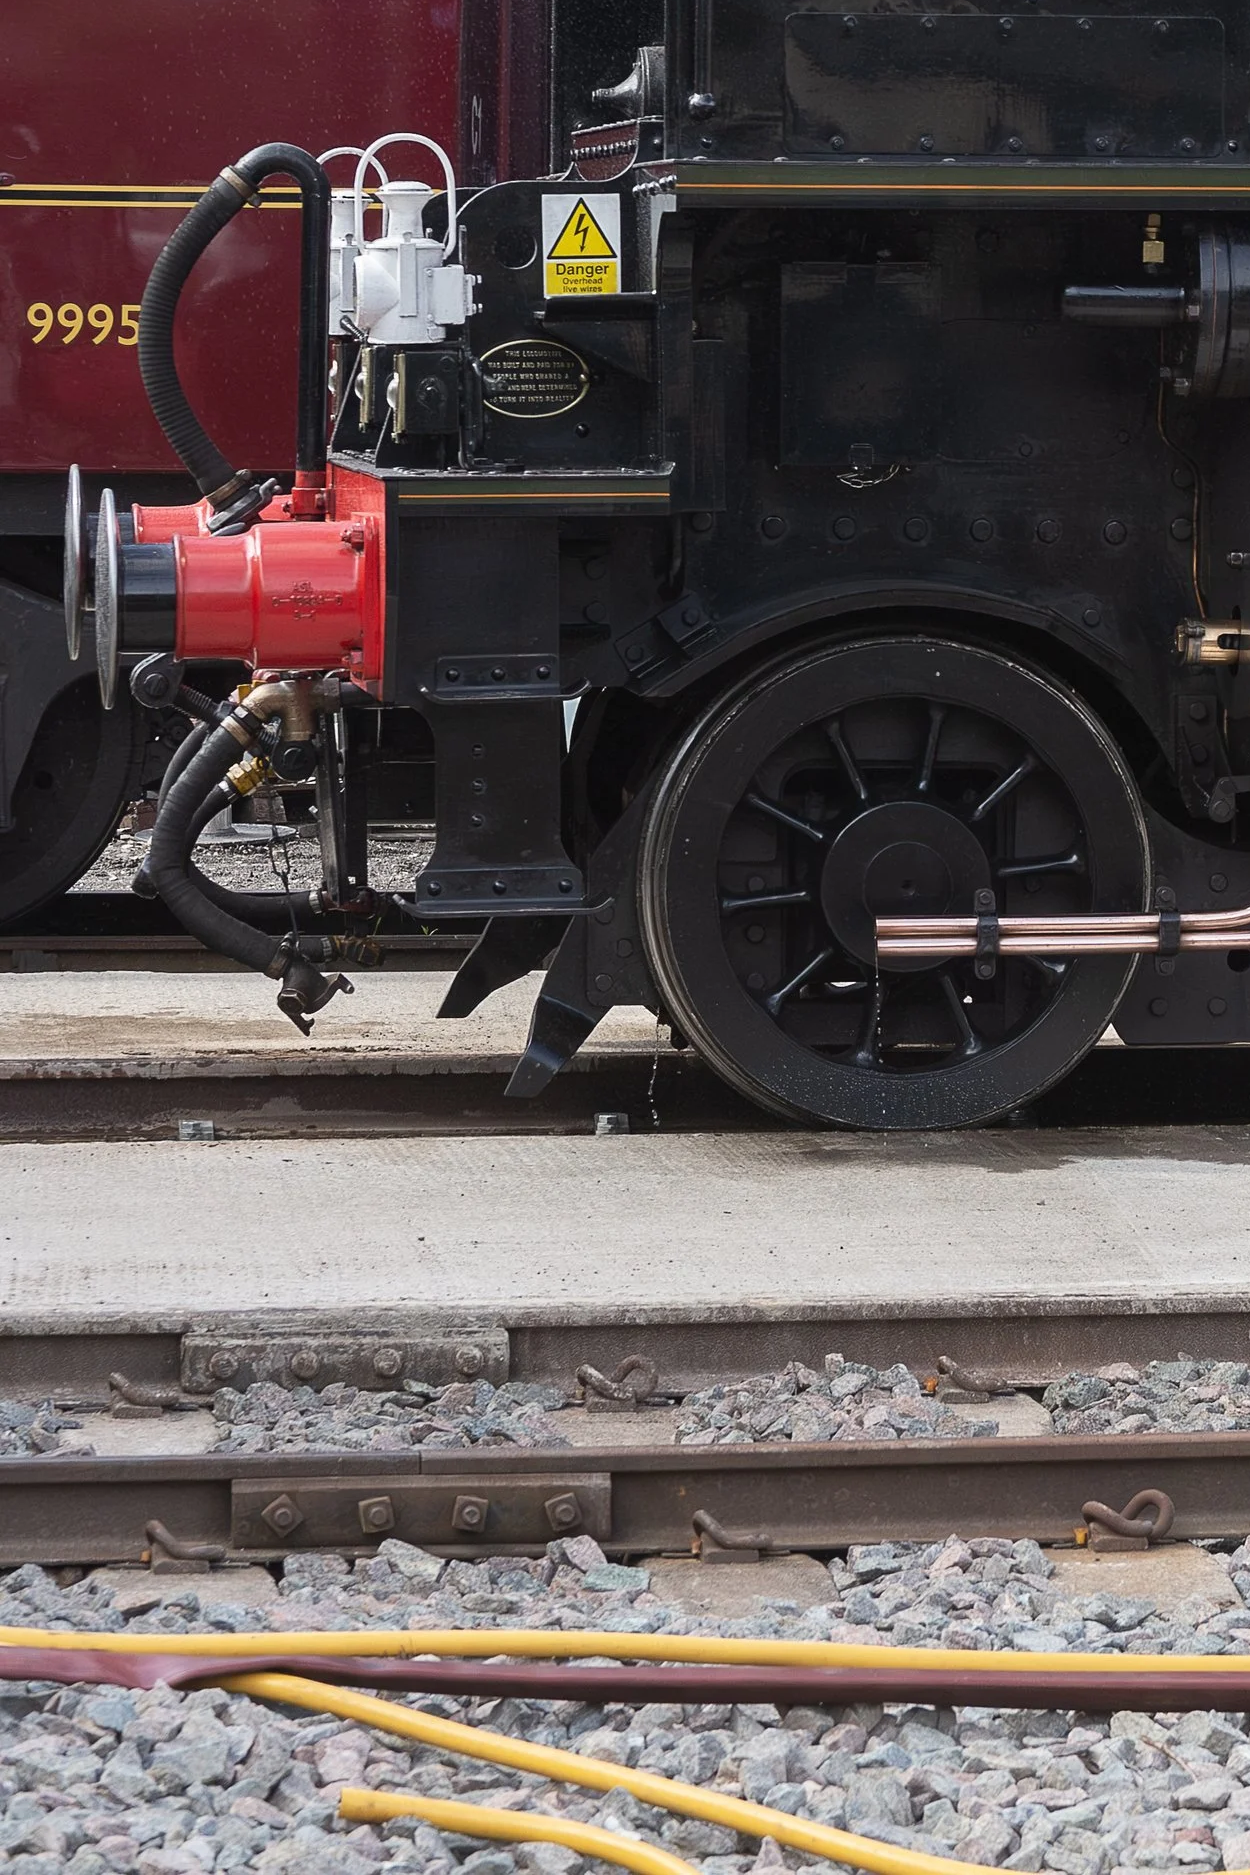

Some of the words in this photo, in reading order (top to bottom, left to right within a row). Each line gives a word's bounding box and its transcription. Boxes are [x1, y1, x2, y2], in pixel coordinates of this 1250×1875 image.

[556, 263, 610, 277] Danger
[562, 277, 603, 285] Overhead
[562, 285, 578, 293] live
[580, 285, 603, 293] wires
